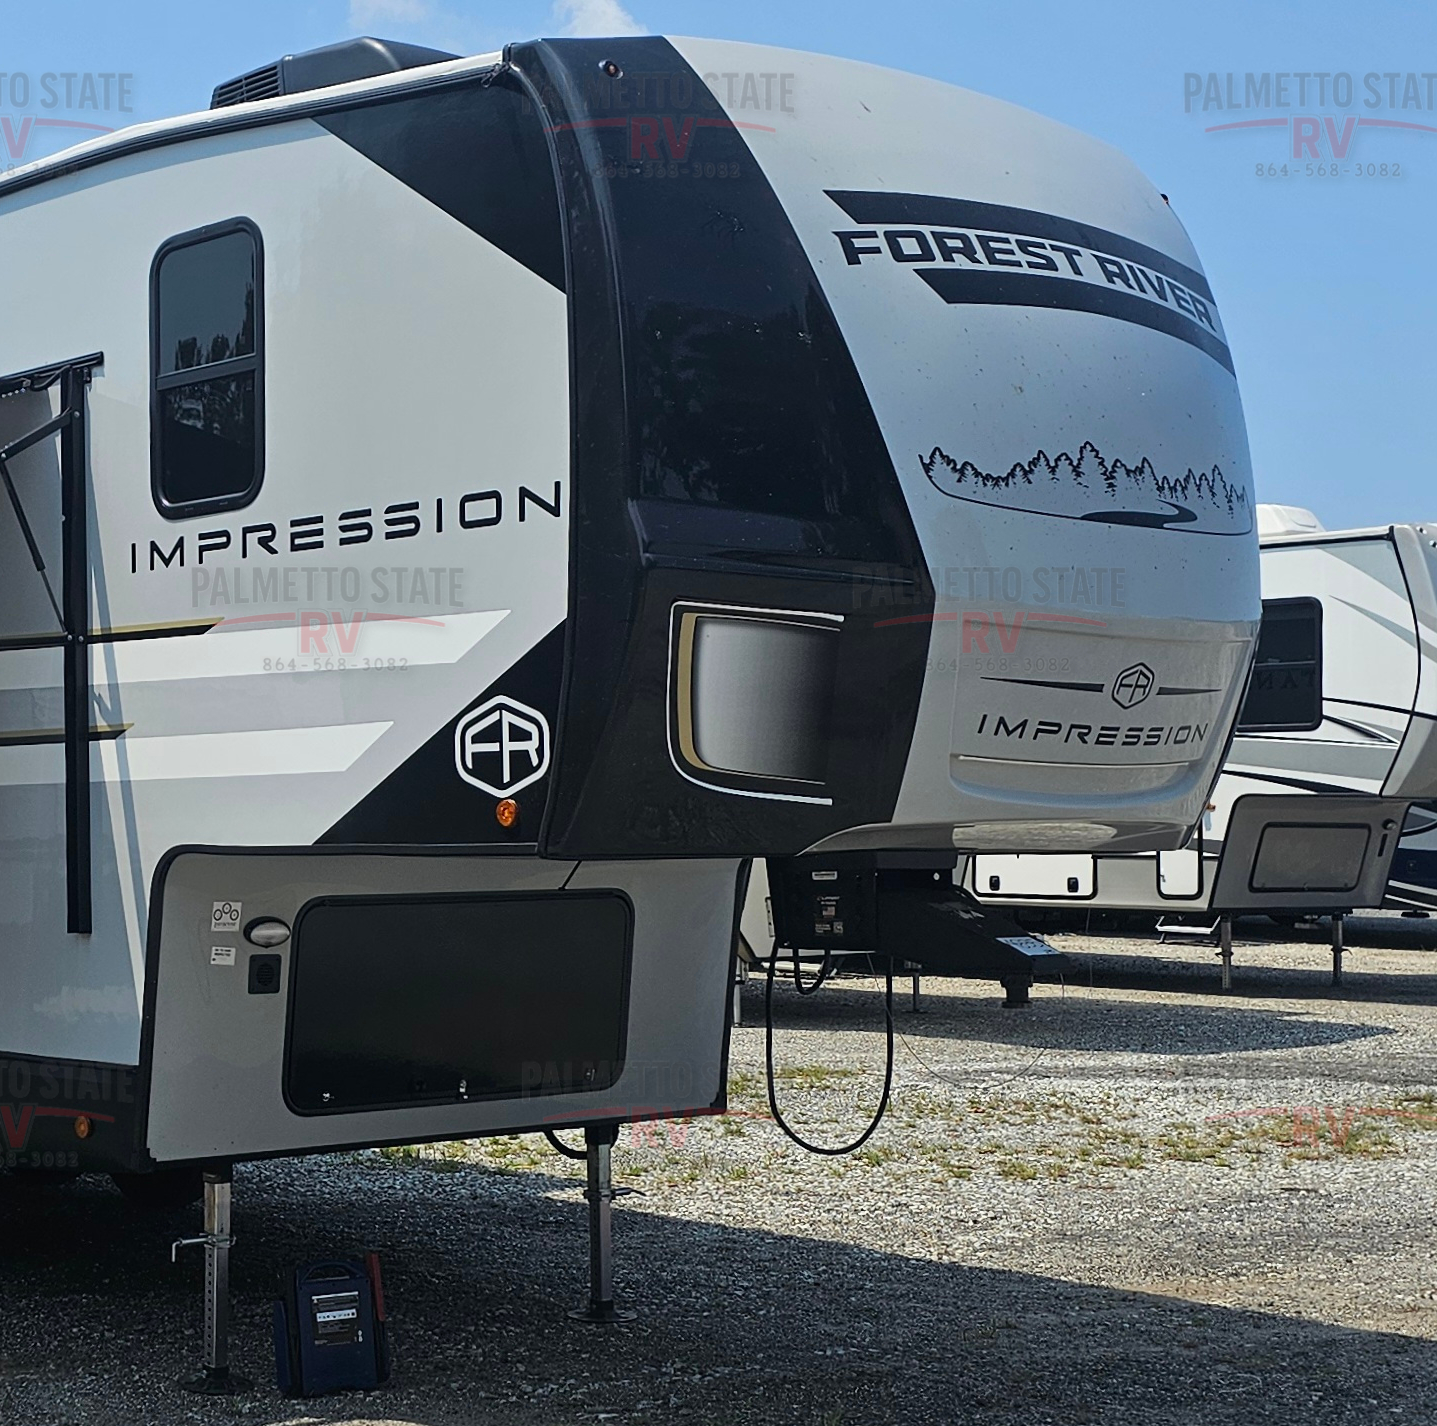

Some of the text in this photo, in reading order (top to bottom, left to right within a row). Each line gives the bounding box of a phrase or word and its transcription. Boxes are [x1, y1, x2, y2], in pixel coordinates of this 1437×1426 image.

[831, 229, 1218, 332] FOREST RIVER
[131, 480, 562, 574] IMPRESSION
[977, 714, 1209, 746] IMPRESSION
